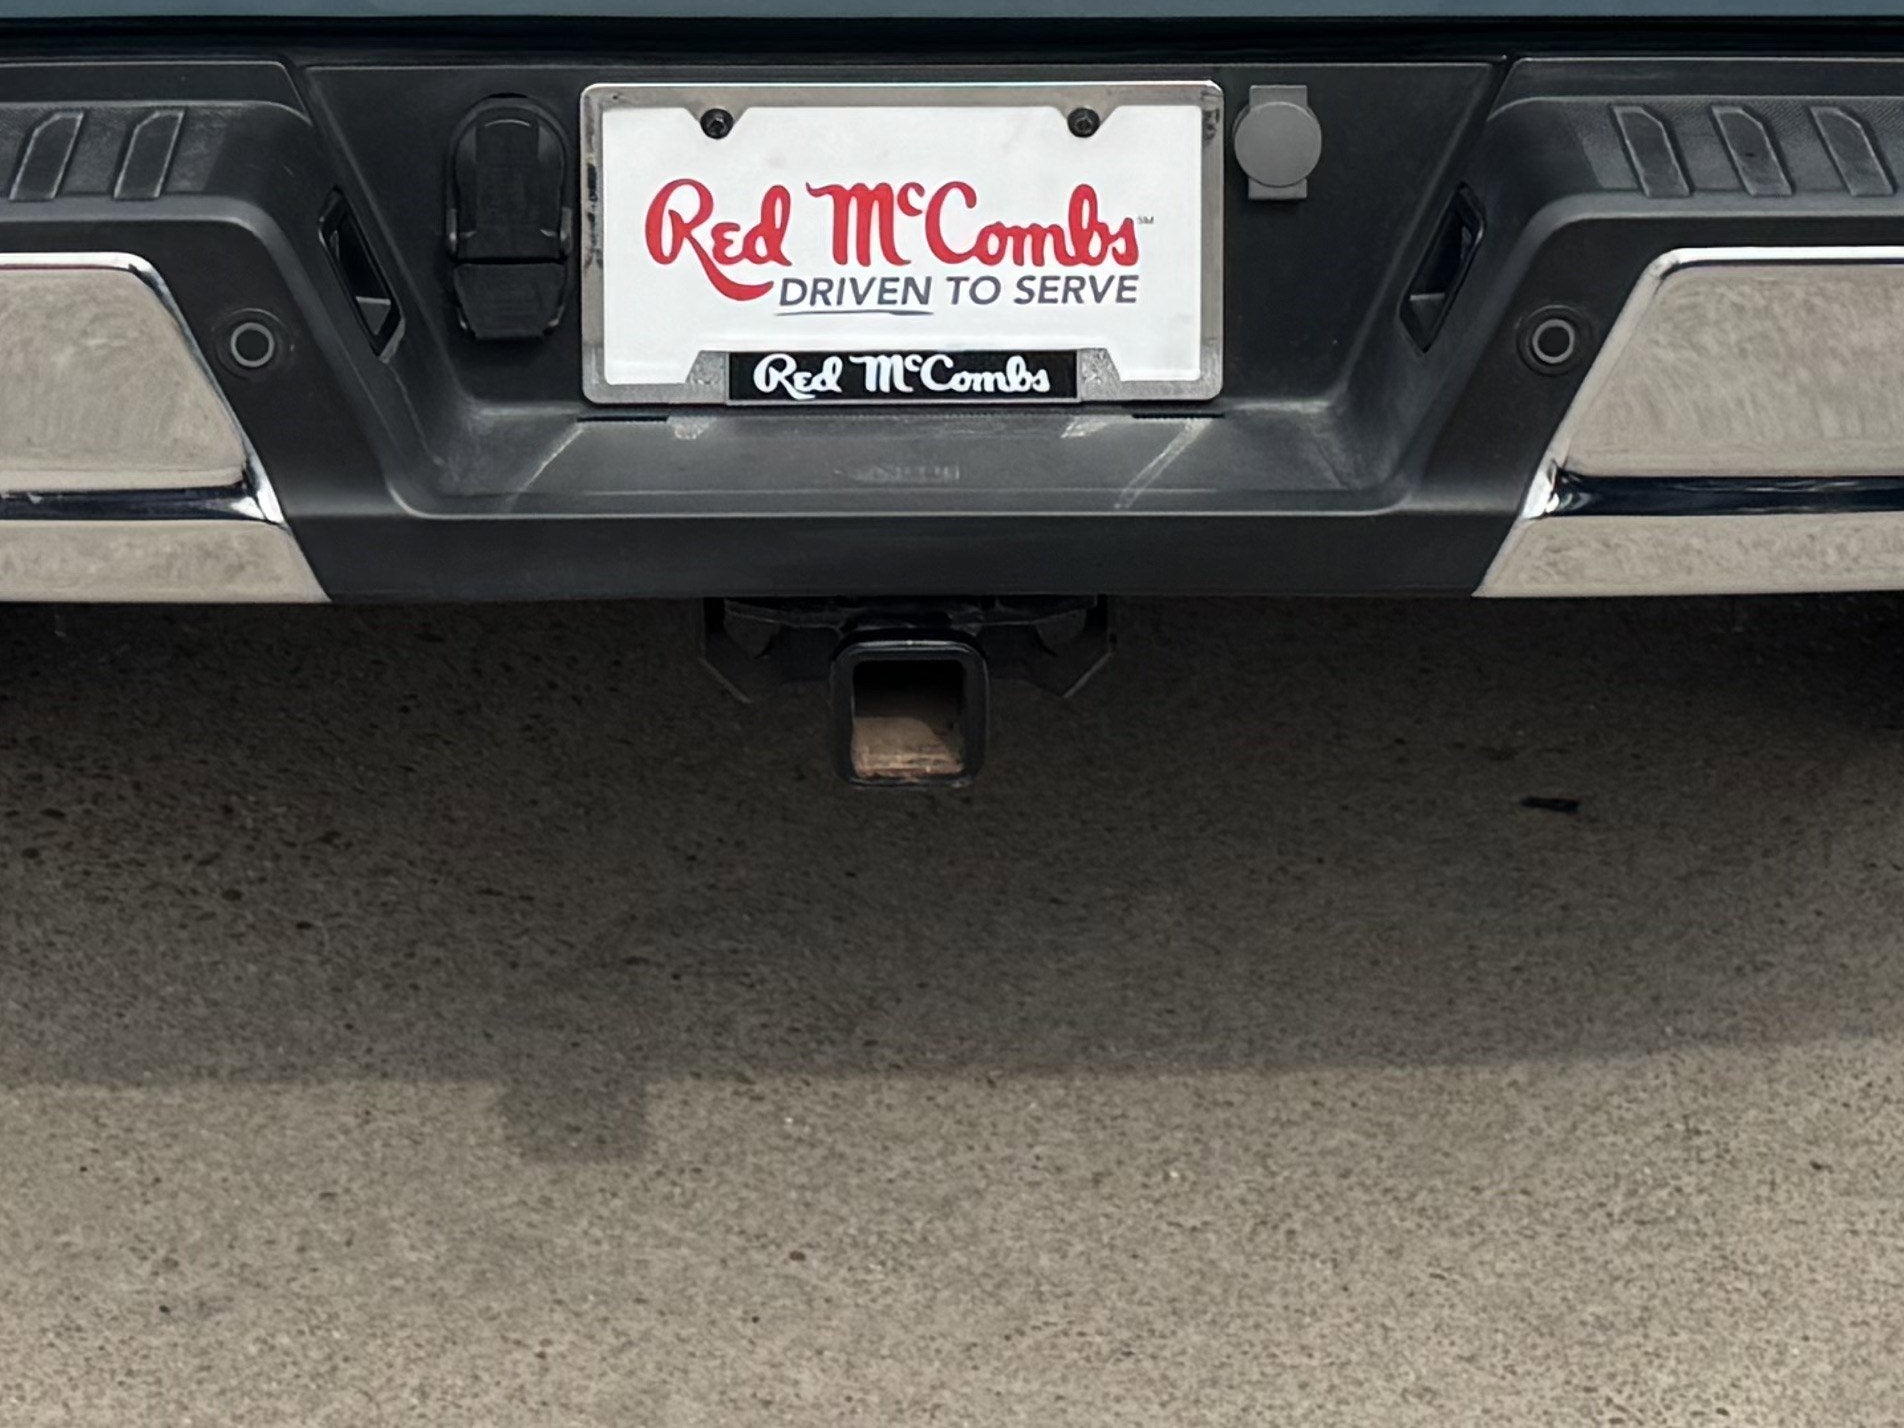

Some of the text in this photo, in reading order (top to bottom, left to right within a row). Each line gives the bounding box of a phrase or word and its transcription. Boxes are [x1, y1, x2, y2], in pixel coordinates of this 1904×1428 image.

[645, 178, 793, 301] Red
[805, 181, 1139, 267] McCombs
[778, 274, 1140, 307] DRIVEN TO SERVE
[752, 352, 1051, 401] Red McCombs
